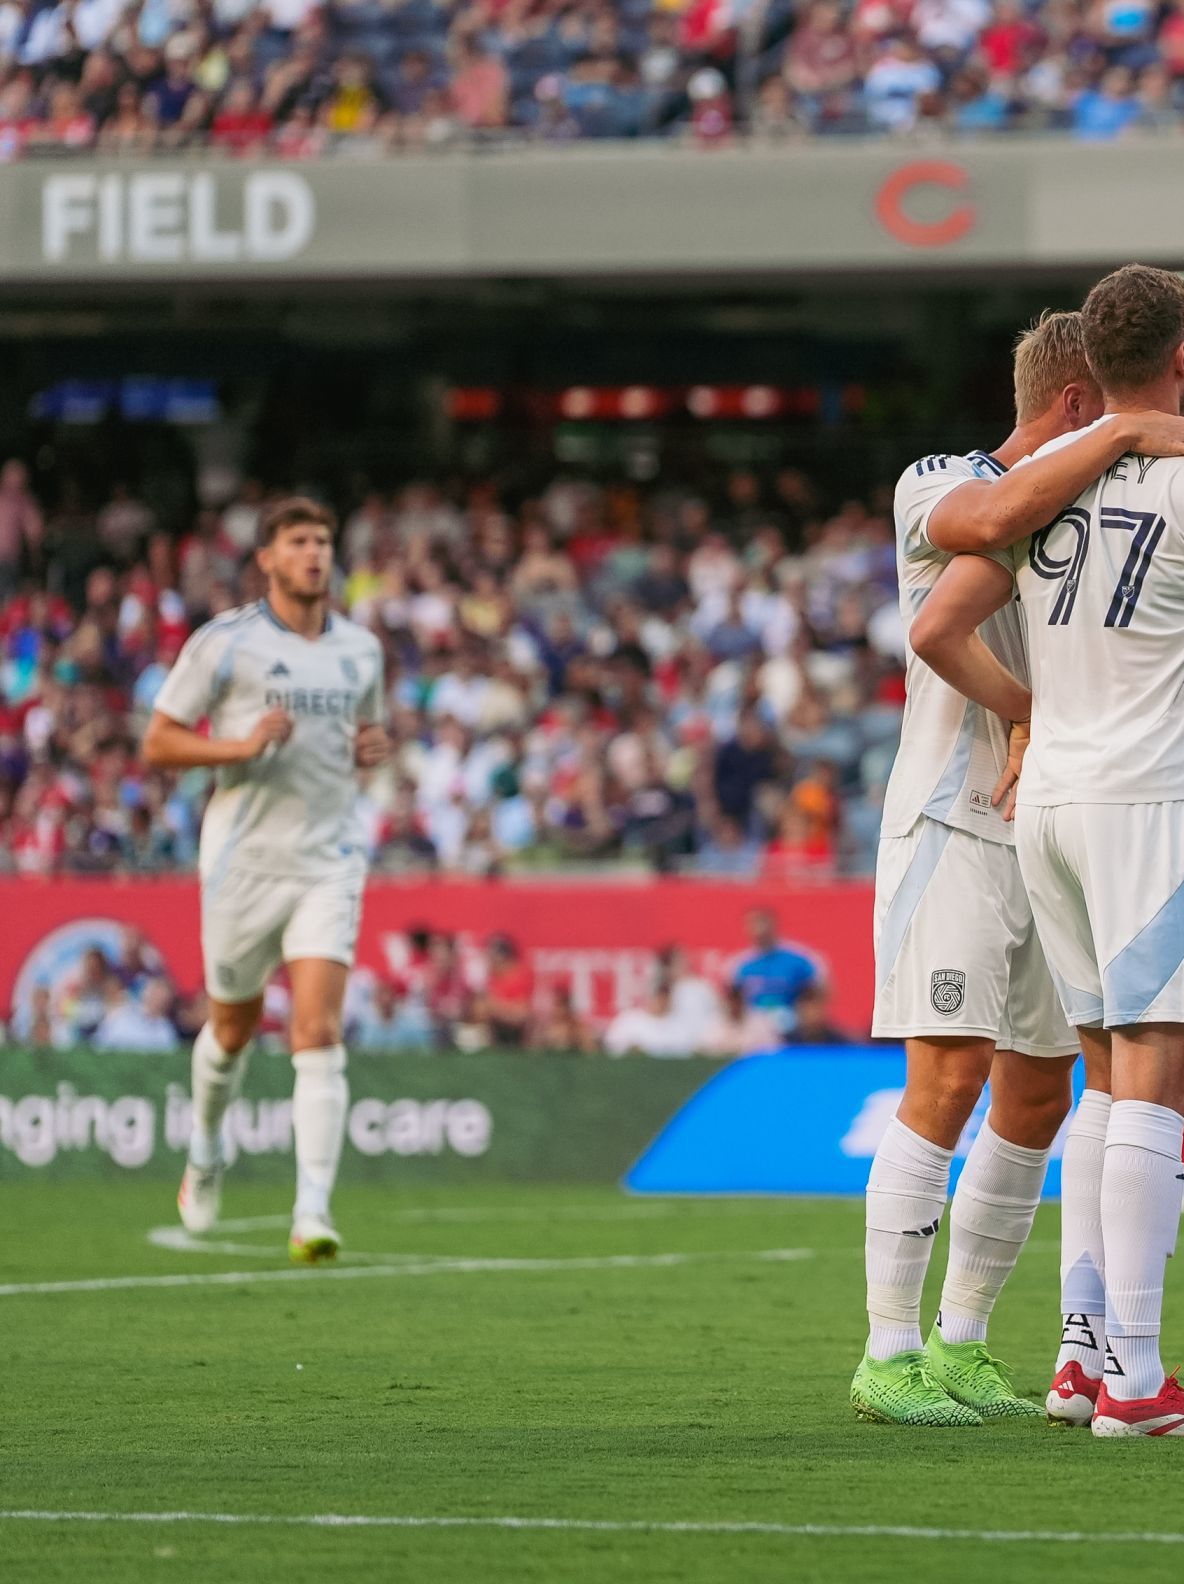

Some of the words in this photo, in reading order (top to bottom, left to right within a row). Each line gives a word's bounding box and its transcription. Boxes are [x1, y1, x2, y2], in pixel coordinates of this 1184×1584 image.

[41, 170, 316, 263] FIELD
[1028, 507, 1167, 628] 97
[350, 1099, 492, 1156] care
